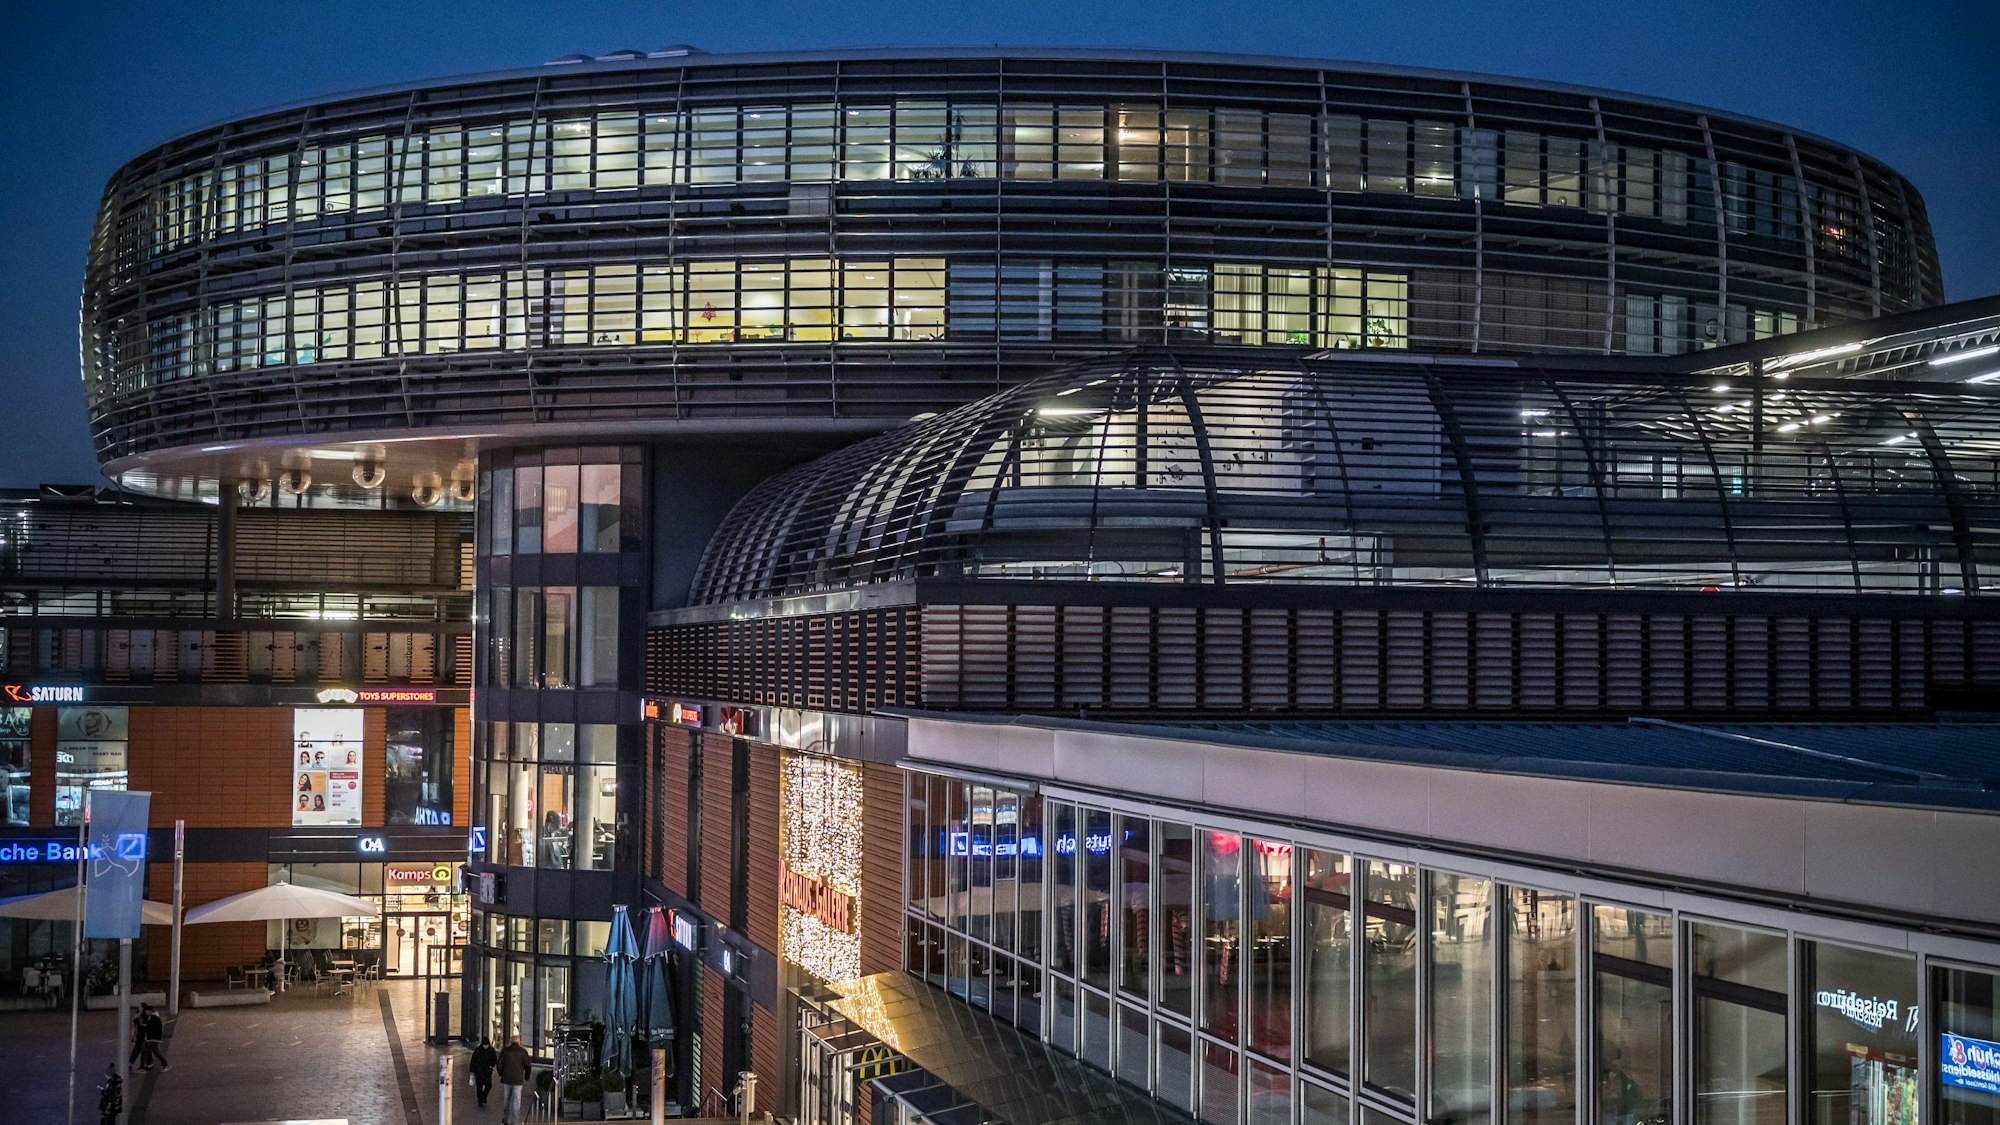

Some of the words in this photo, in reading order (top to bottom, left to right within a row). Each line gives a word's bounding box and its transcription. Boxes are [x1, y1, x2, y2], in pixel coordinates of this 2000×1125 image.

[32, 687, 83, 701] SATURN
[359, 692, 380, 701] TOYS
[380, 692, 434, 701] SUPERSTORES
[47, 843, 104, 860] Bank
[388, 869, 431, 881] Kamps
